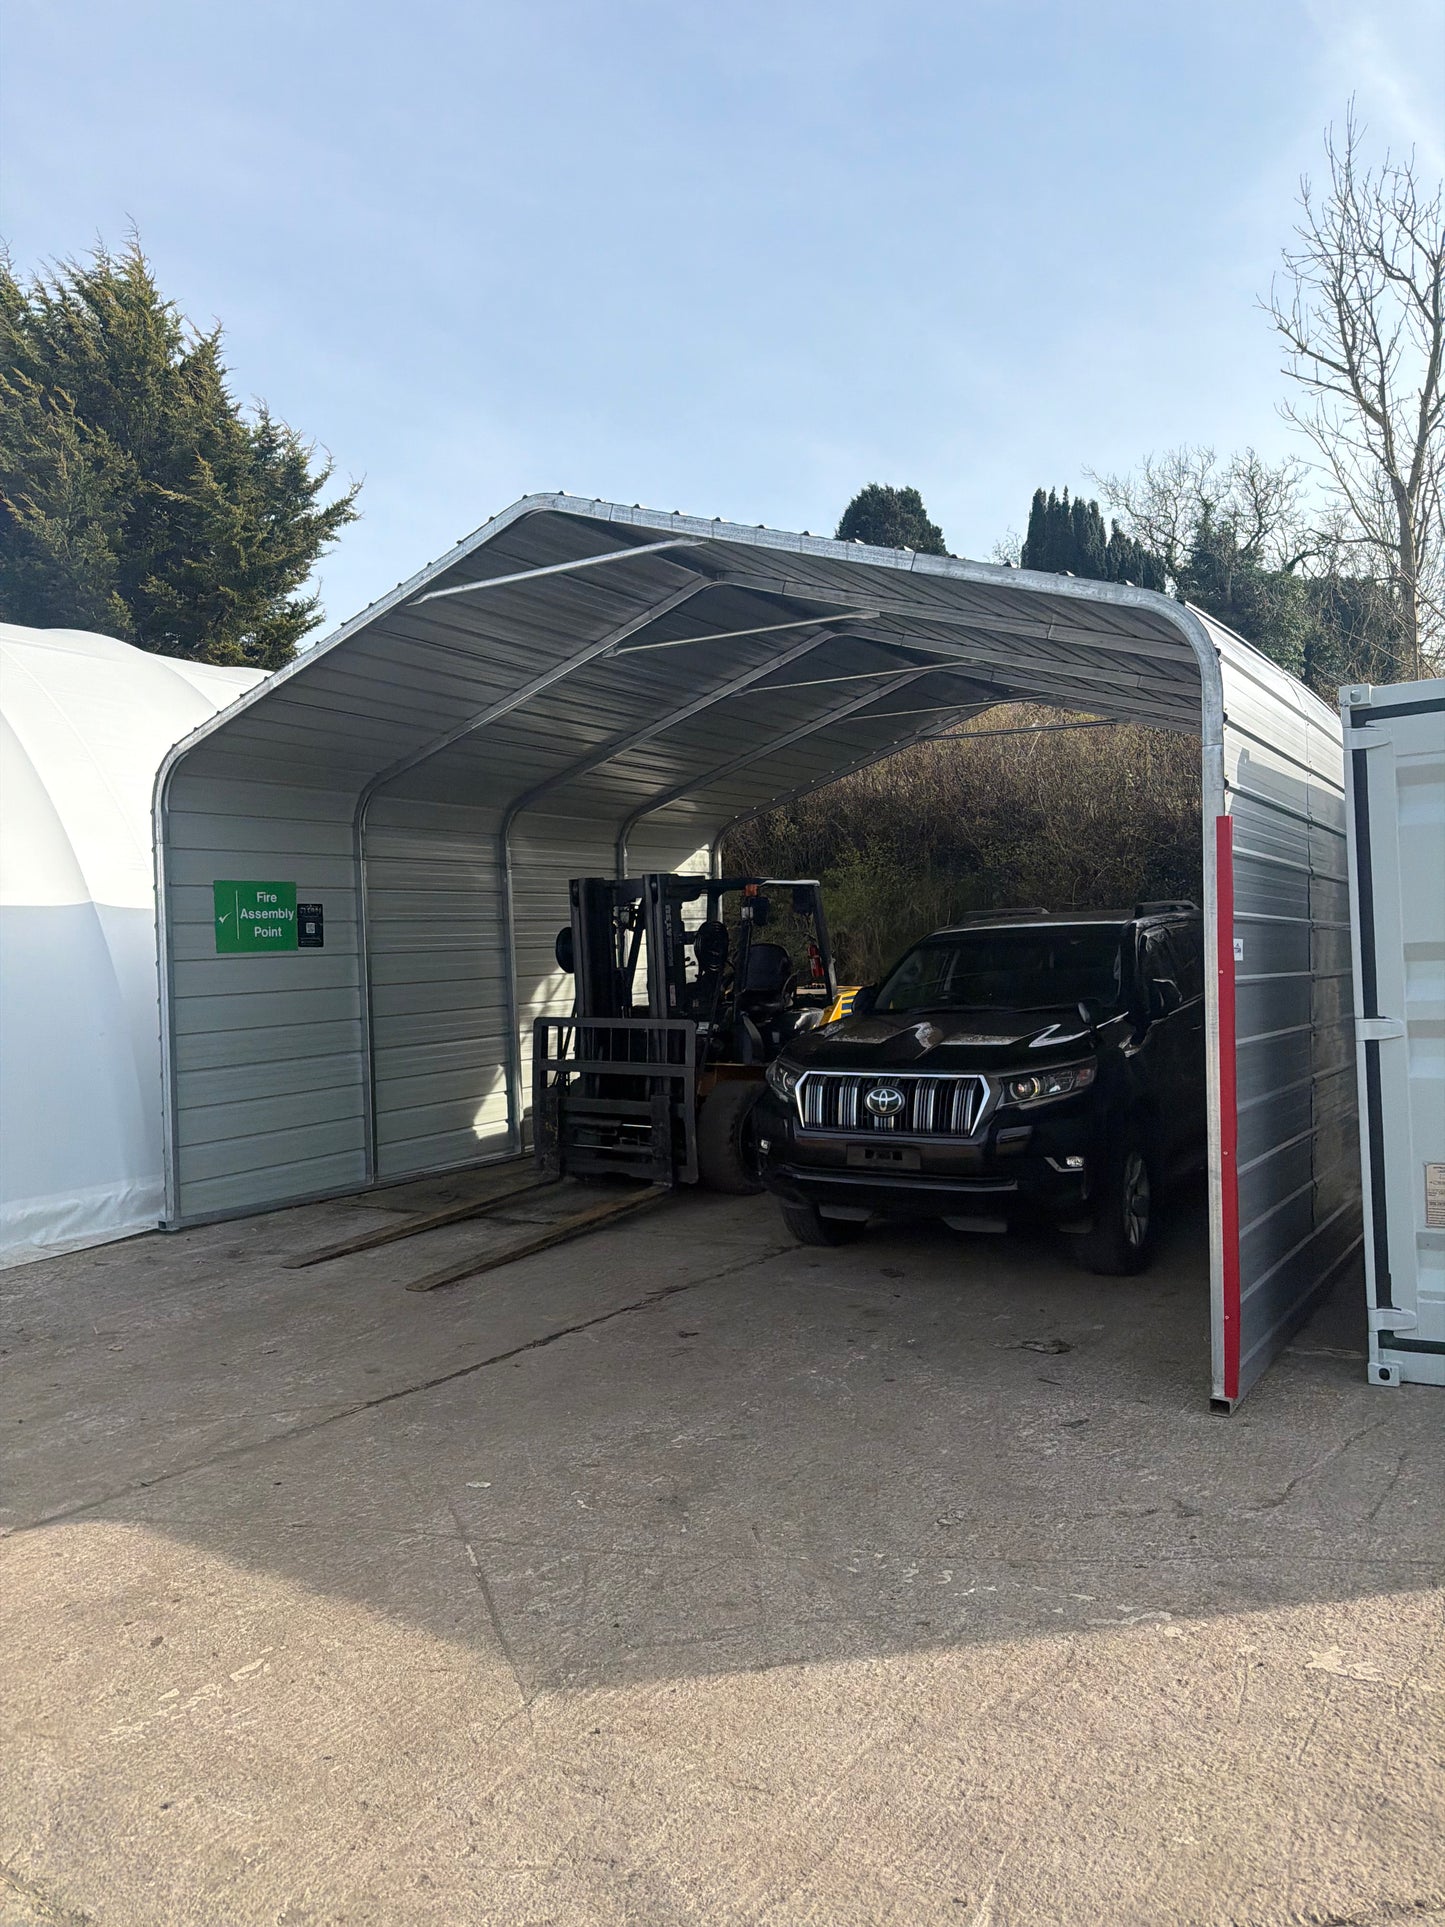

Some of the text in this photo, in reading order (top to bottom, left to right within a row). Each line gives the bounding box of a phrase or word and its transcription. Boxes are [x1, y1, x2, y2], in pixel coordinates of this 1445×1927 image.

[256, 891, 277, 903] Fire
[240, 908, 294, 921] Assembly
[254, 926, 282, 938] Point
